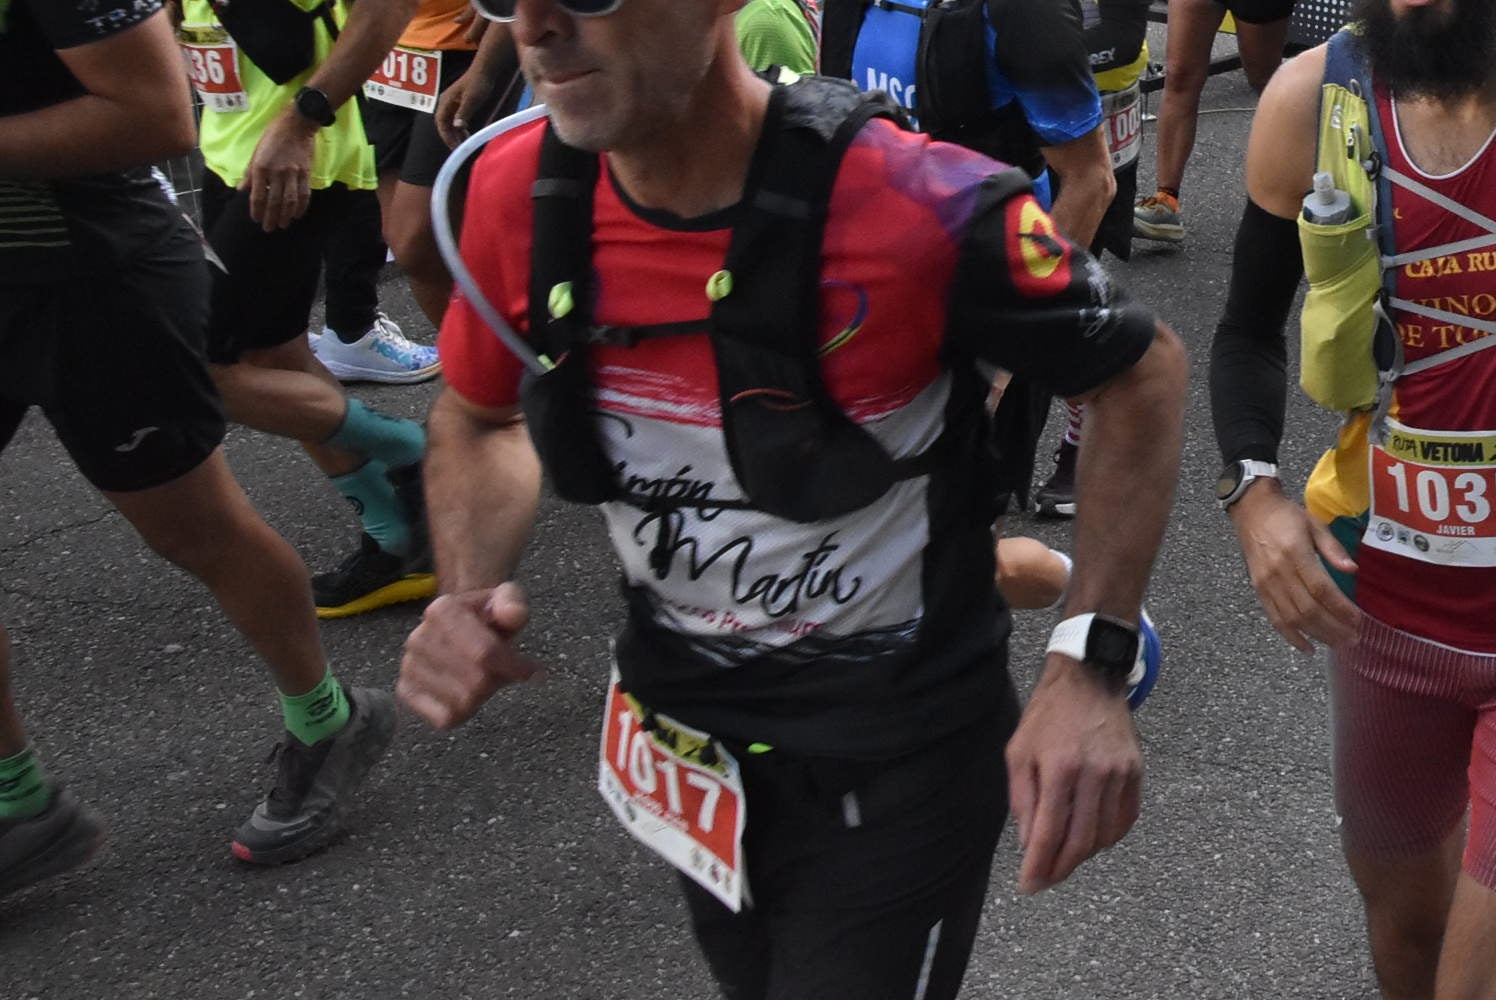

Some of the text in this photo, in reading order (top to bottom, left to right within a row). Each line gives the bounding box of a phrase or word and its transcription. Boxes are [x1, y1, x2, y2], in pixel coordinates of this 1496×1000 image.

[376, 51, 427, 86] 018
[1420, 440, 1484, 463] VETONA
[1436, 524, 1476, 537] JAVIER
[617, 710, 721, 833] 1017
